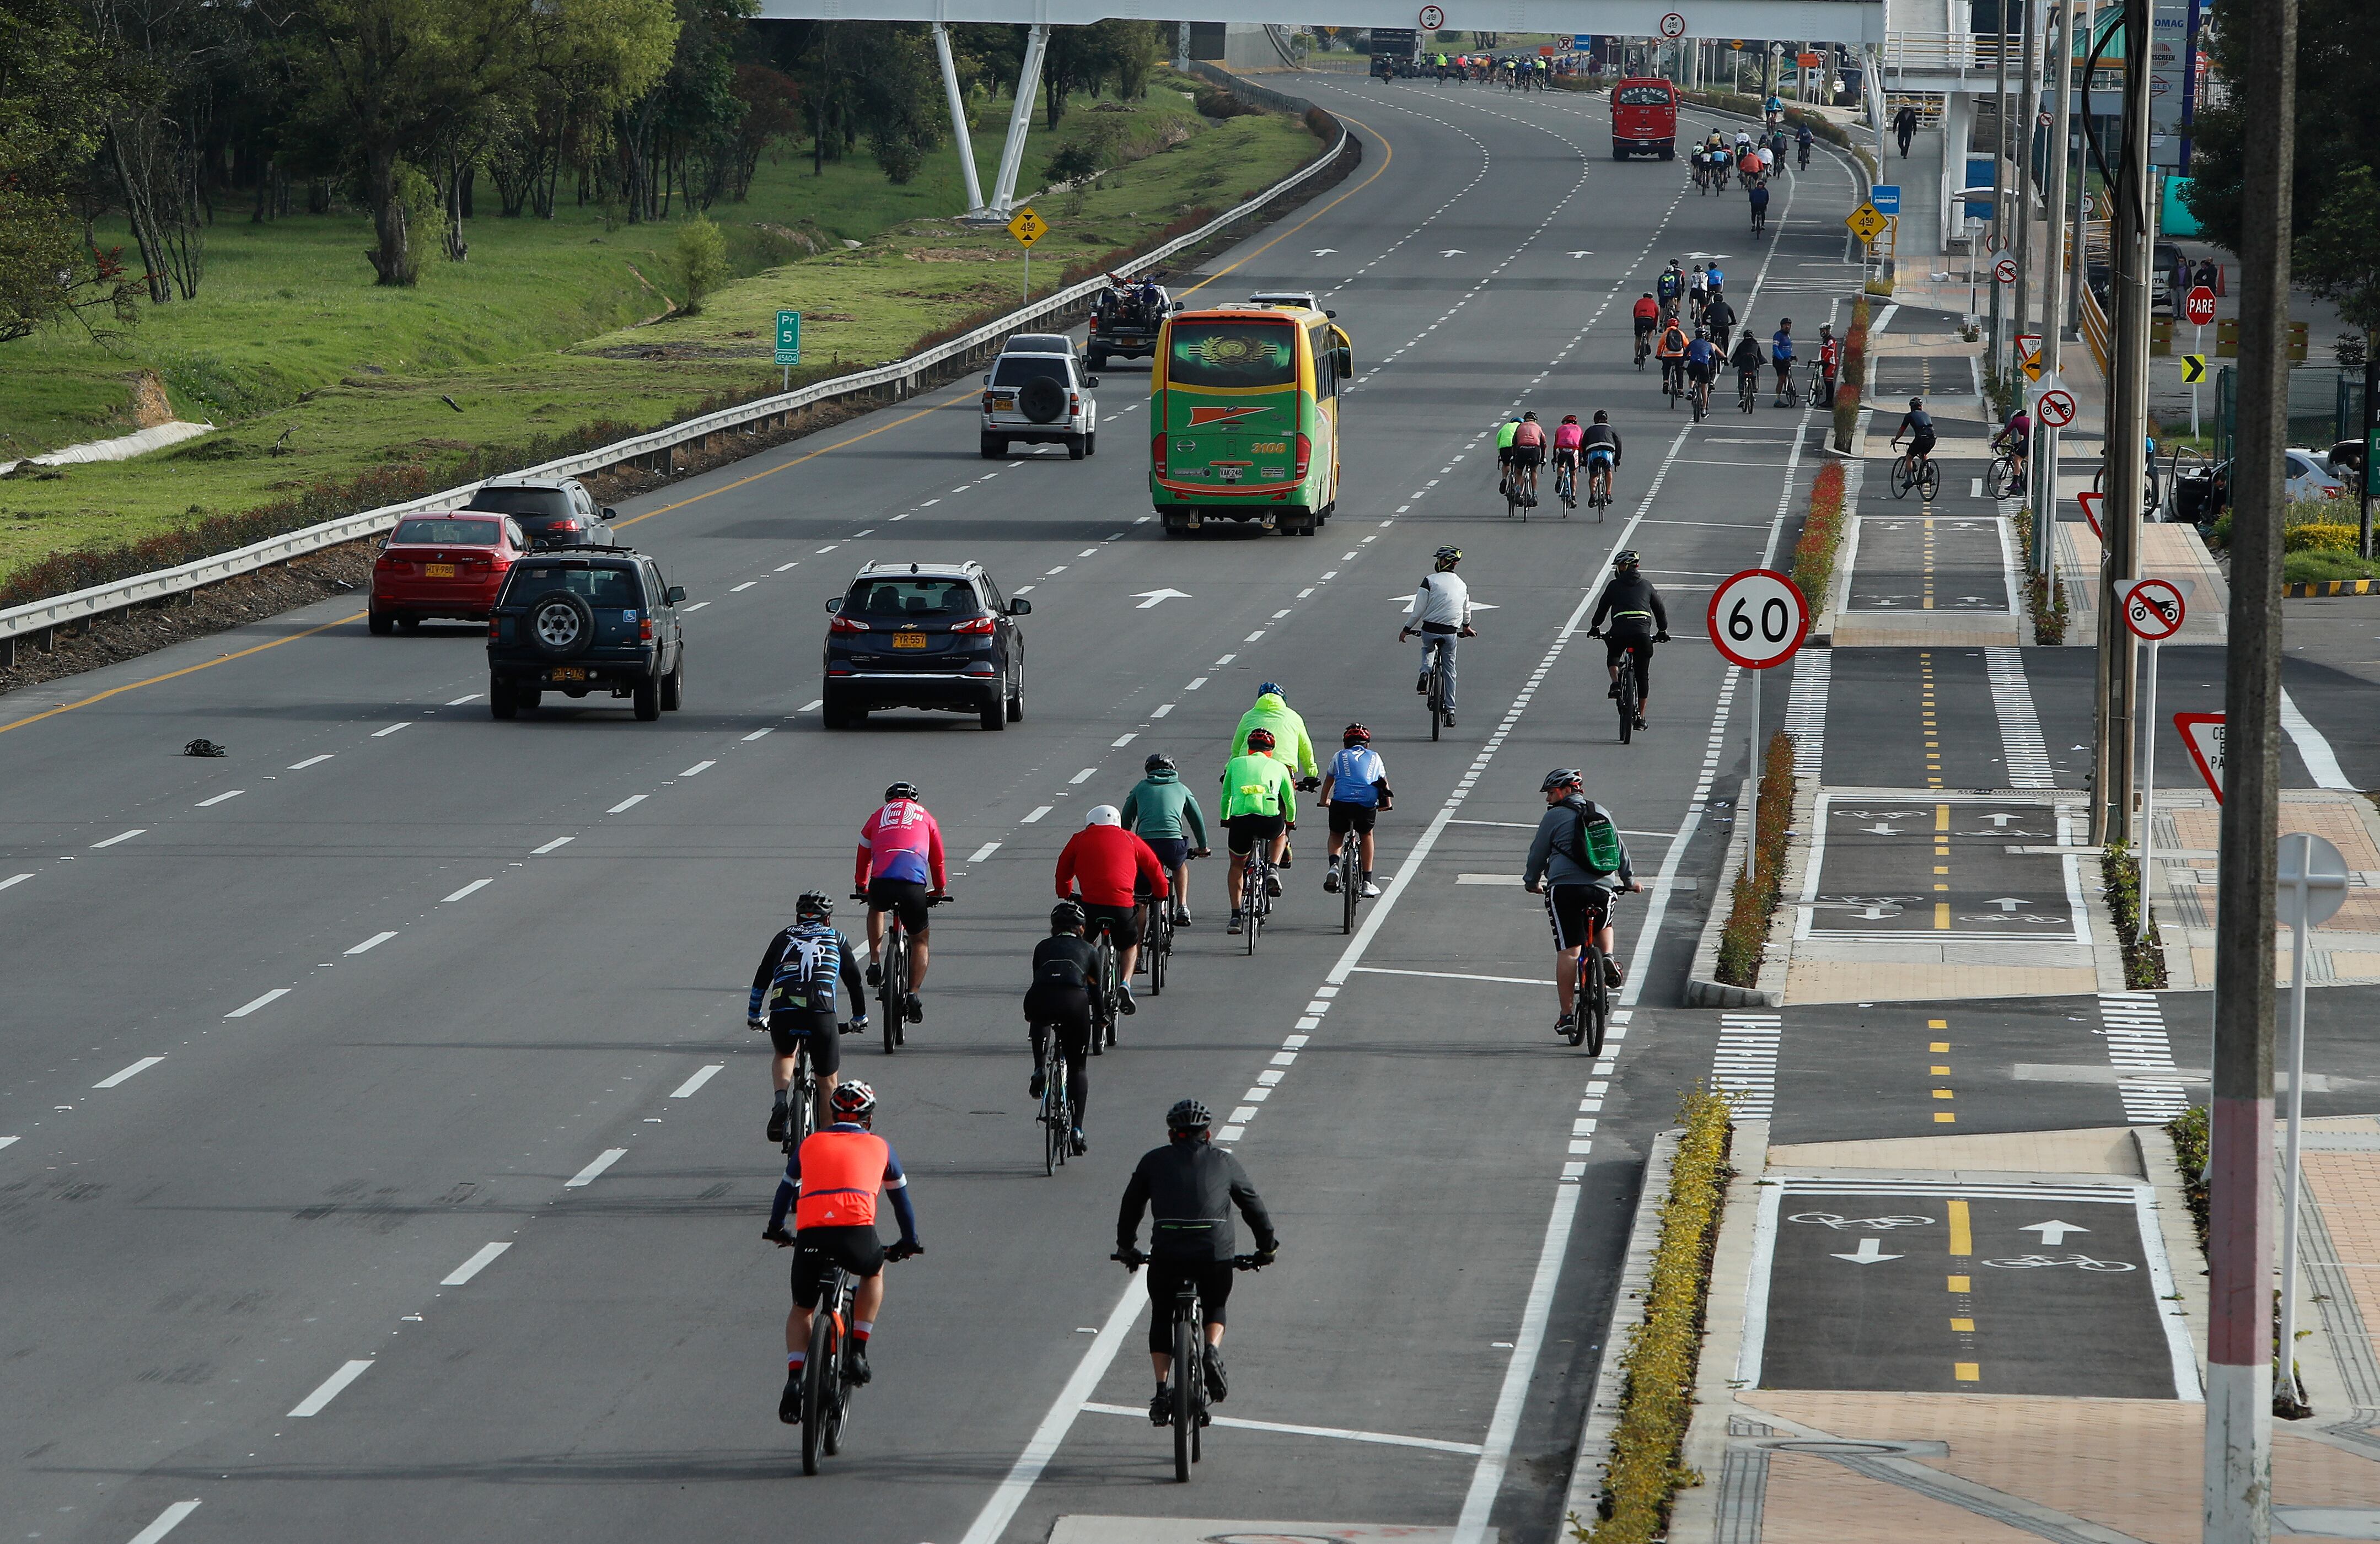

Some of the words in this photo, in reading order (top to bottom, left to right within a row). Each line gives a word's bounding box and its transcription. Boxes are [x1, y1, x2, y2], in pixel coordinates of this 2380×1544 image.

[1620, 87, 1669, 101] ALIANZA
[2189, 299, 2214, 313] PARE
[782, 315, 794, 325] Pr
[783, 331, 792, 342] 5
[1251, 443, 1287, 454] 3108
[1728, 597, 1788, 643] 60
[894, 635, 925, 644] FYR-557
[880, 801, 925, 827] EF
